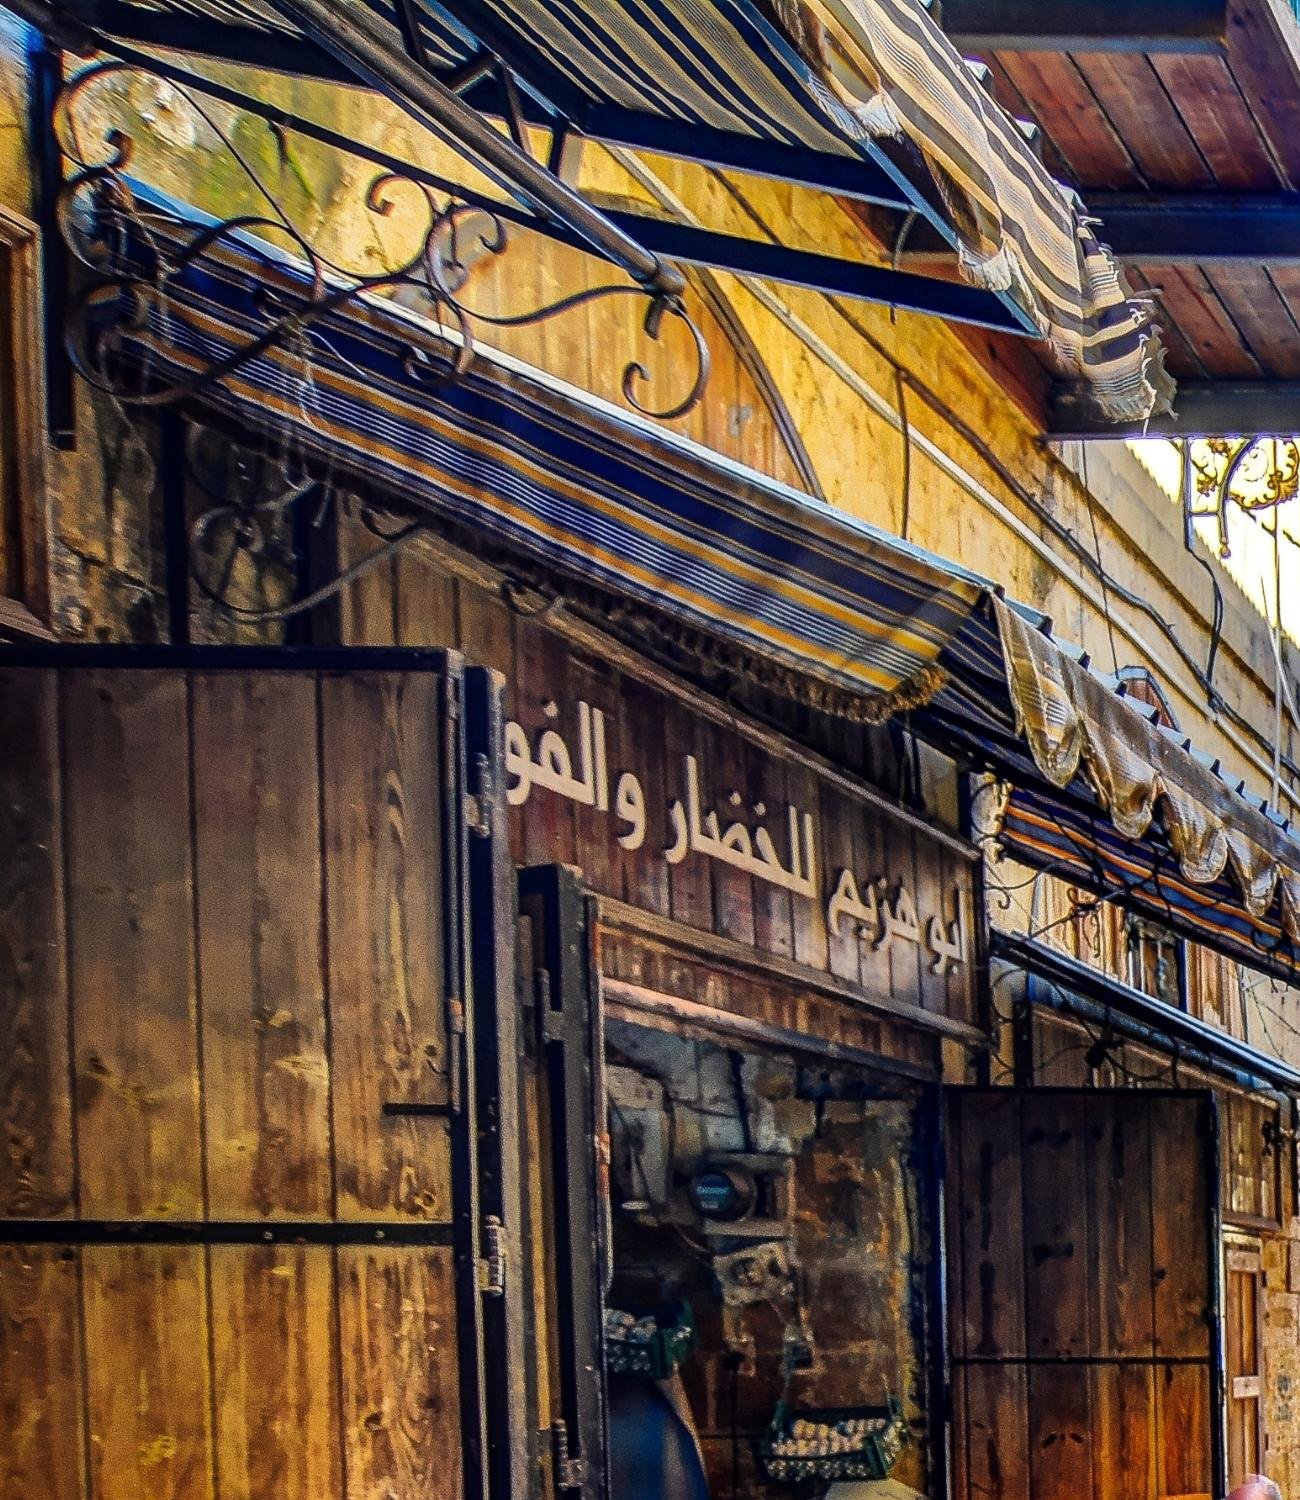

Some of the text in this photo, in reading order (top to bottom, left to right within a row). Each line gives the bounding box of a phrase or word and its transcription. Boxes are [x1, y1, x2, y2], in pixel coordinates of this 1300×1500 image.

[504, 700, 648, 851] والفو
[664, 755, 817, 898] للخضار
[930, 885, 967, 975] ابو
